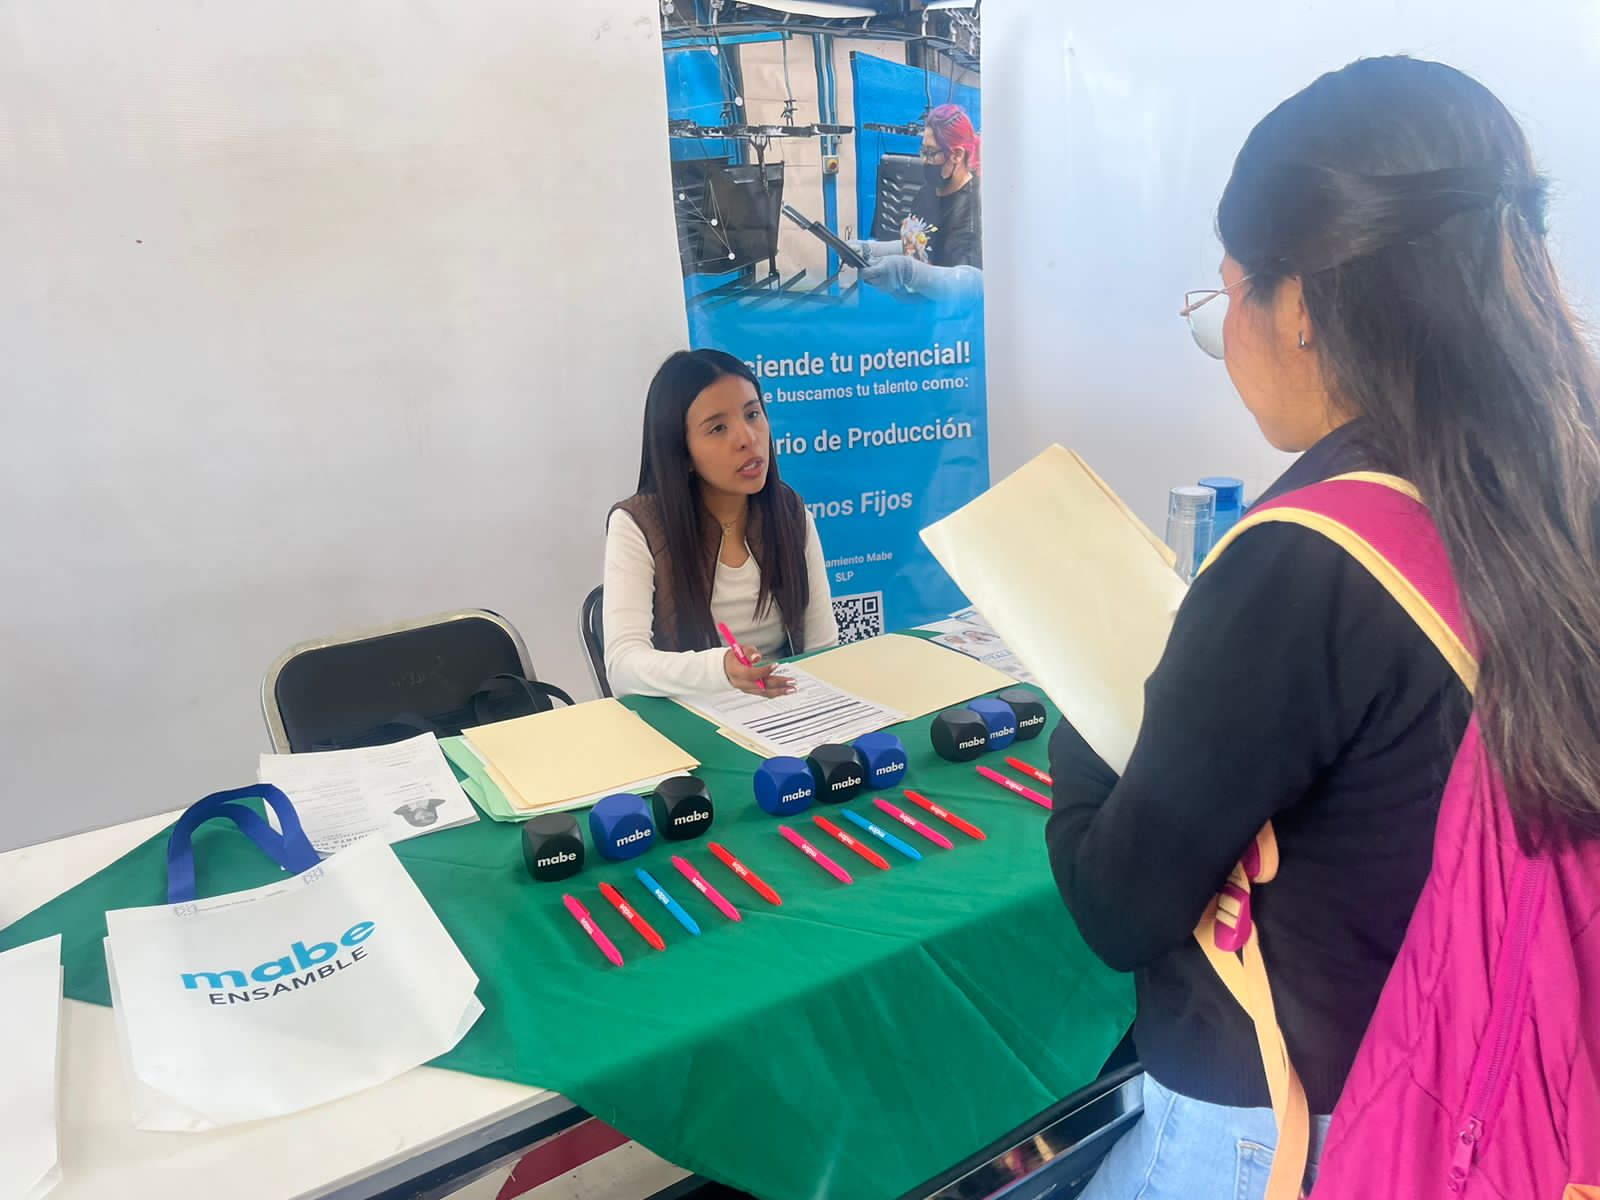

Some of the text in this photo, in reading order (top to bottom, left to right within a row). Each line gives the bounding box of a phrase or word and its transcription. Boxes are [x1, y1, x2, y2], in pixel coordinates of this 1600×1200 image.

[830, 351, 853, 373] tu
[860, 341, 971, 377] potencial!
[777, 385, 853, 403] buscamos
[856, 384, 870, 397] tu
[873, 381, 918, 395] talento
[921, 376, 969, 391] como:
[774, 417, 972, 456] rio de Producción
[861, 490, 913, 517] Fijos
[867, 551, 893, 562] Mabe
[835, 571, 855, 582] SLP
[1019, 714, 1044, 729] mabe
[990, 725, 1015, 740] mabe
[959, 735, 985, 750] mabe
[875, 760, 905, 776] mabe
[831, 776, 862, 791] mabe
[782, 787, 812, 803] mabe
[674, 809, 709, 825] mabe
[616, 827, 651, 847] mabe
[537, 852, 577, 868] mabe
[180, 920, 376, 990] mabe
[208, 945, 368, 1006] ENSAMBLE
